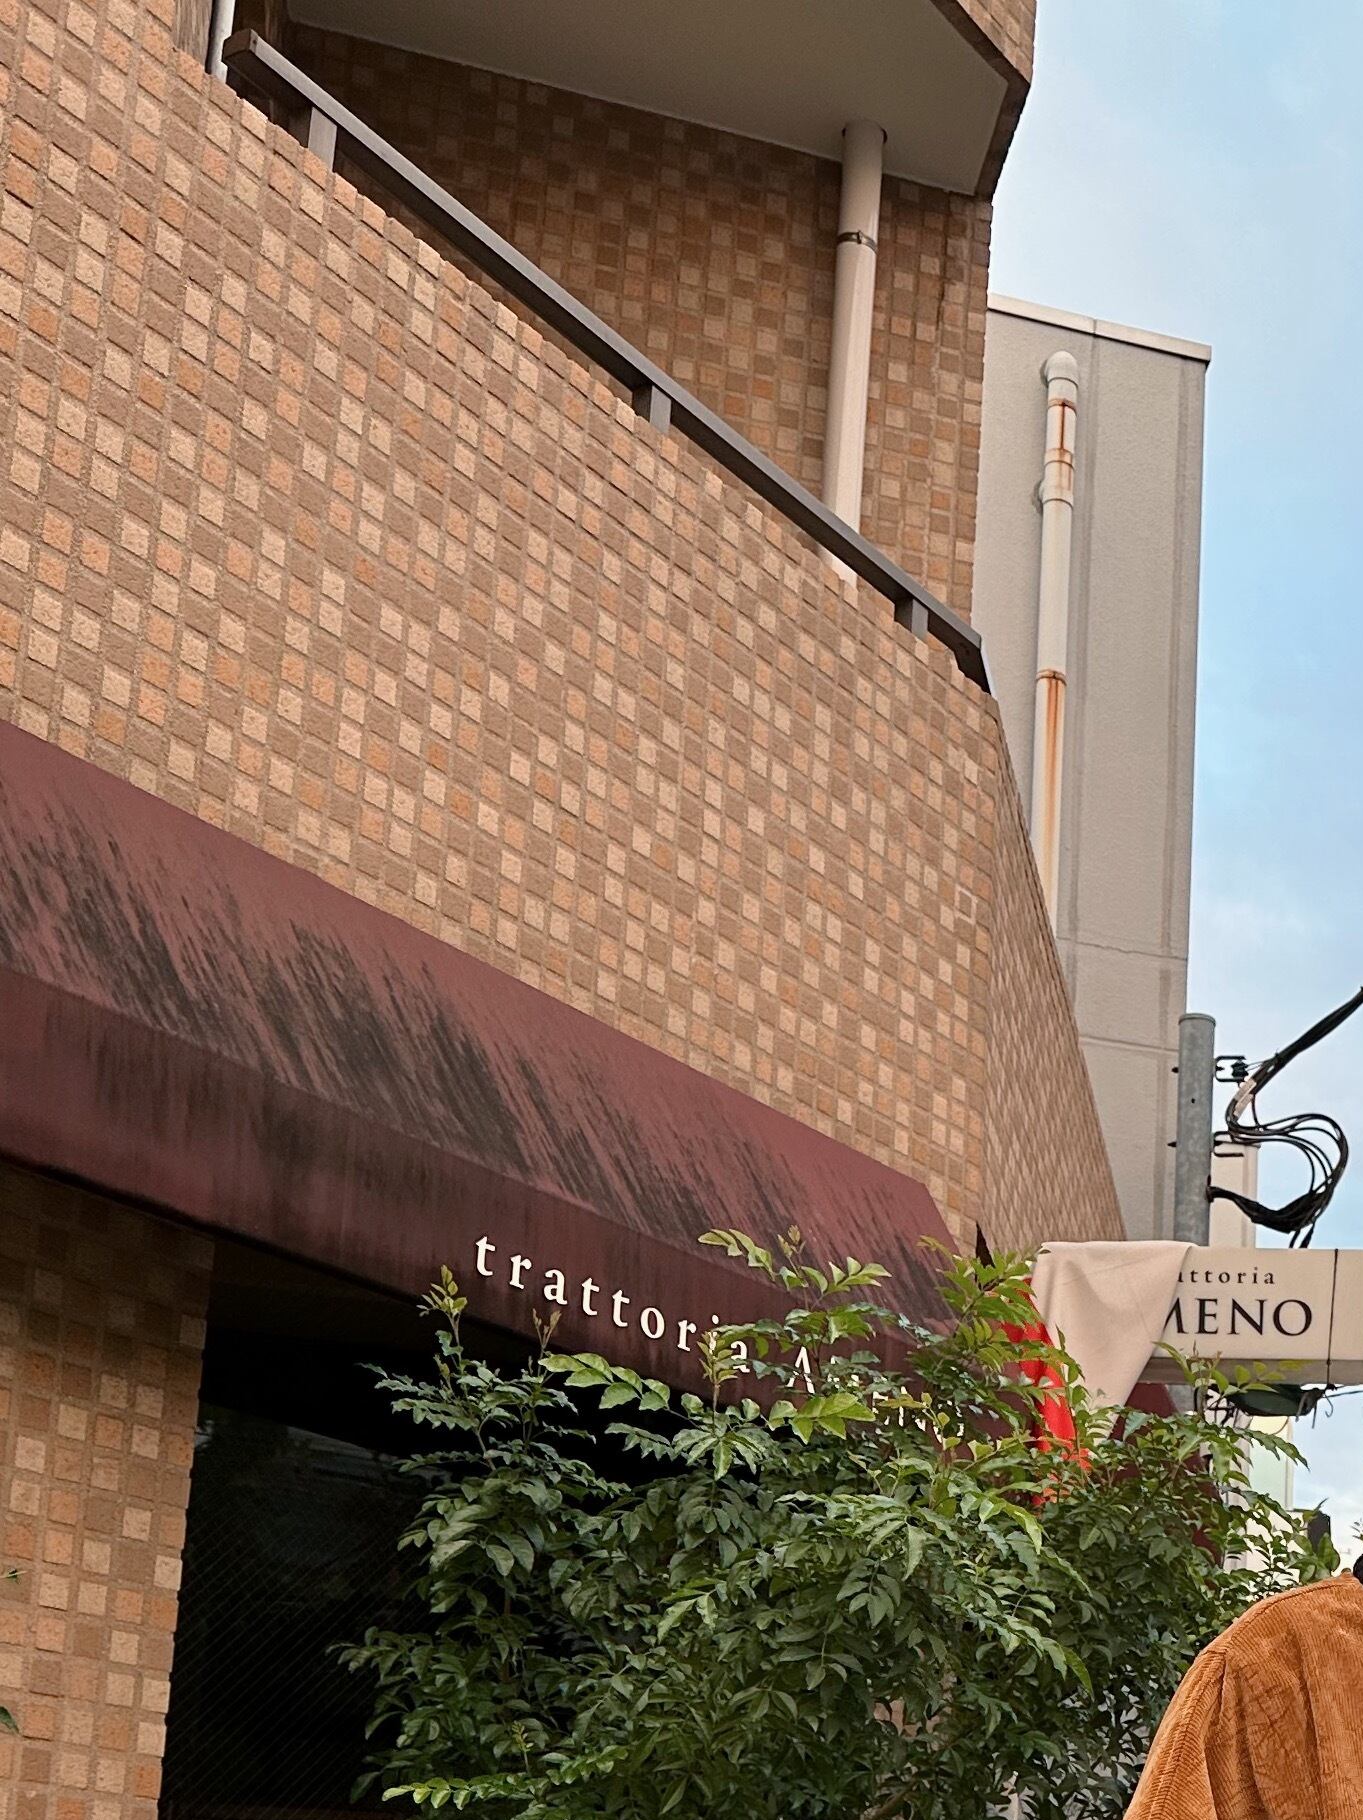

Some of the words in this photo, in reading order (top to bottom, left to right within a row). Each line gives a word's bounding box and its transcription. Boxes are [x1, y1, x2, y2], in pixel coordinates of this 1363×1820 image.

[1177, 1266, 1275, 1285] ttoria
[475, 1236, 750, 1373] trattoria
[1163, 1296, 1313, 1337] MENO
